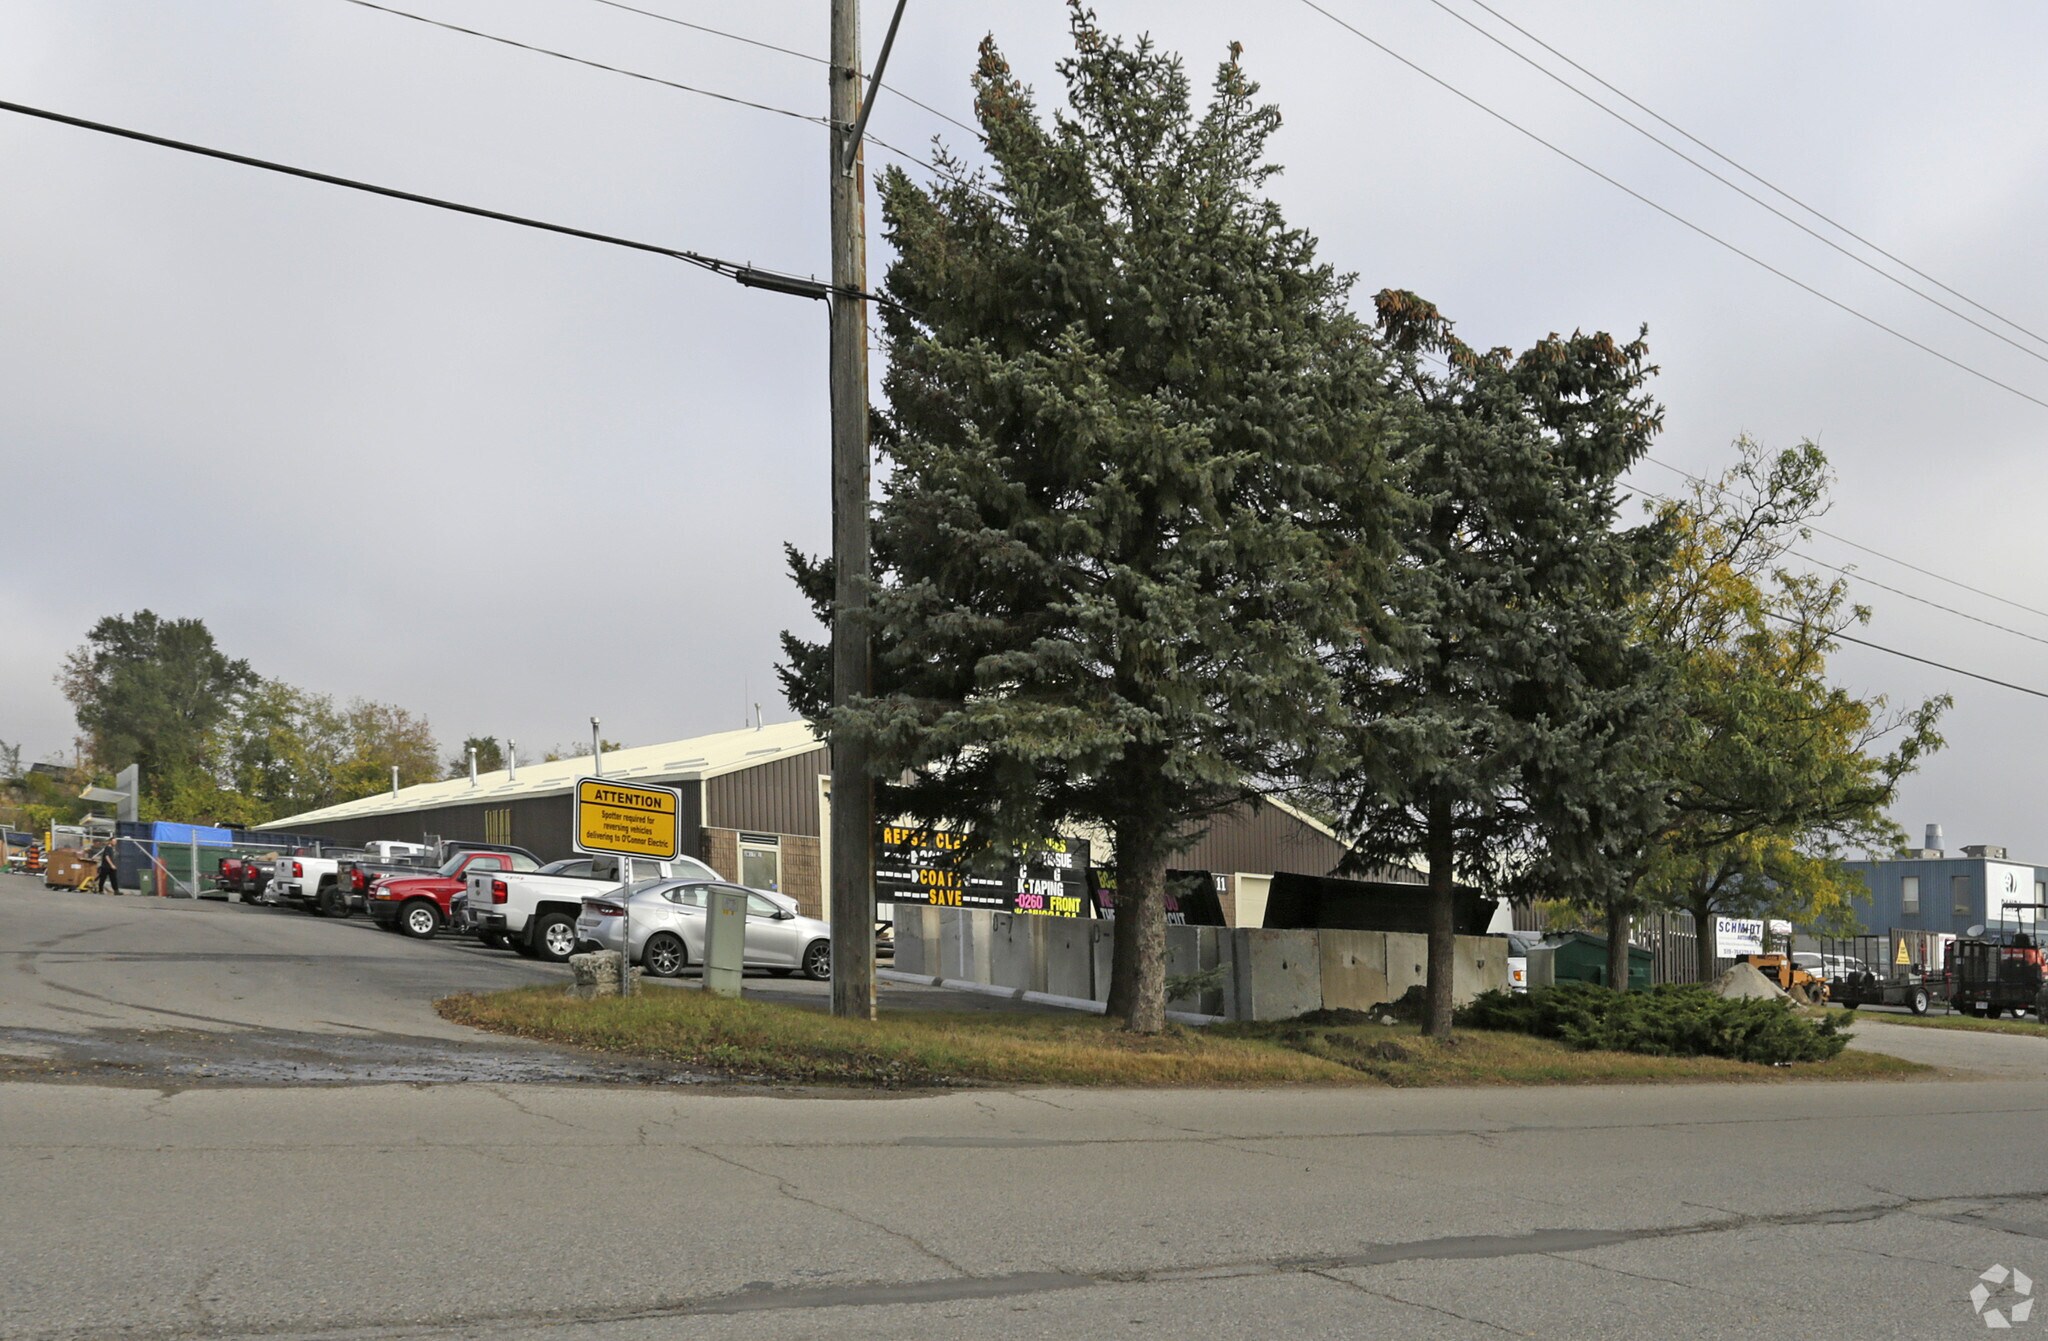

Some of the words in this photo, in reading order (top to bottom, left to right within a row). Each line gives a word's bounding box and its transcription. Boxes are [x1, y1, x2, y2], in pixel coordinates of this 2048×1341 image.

[595, 790, 662, 808] ATTENTION
[602, 810, 622, 820] Spotter
[623, 813, 646, 824] required
[647, 816, 655, 824] for
[604, 824, 629, 834] reversing
[631, 826, 652, 835] vehicles
[587, 831, 613, 843] delivering
[622, 835, 646, 844] O'Connor
[648, 838, 668, 848] Electric
[1017, 878, 1064, 897] K-TAPING
[1216, 877, 1226, 891] 11
[929, 888, 962, 906] SAVE
[1050, 896, 1081, 912] FRONT
[1718, 921, 1761, 935] SCHMIDT
